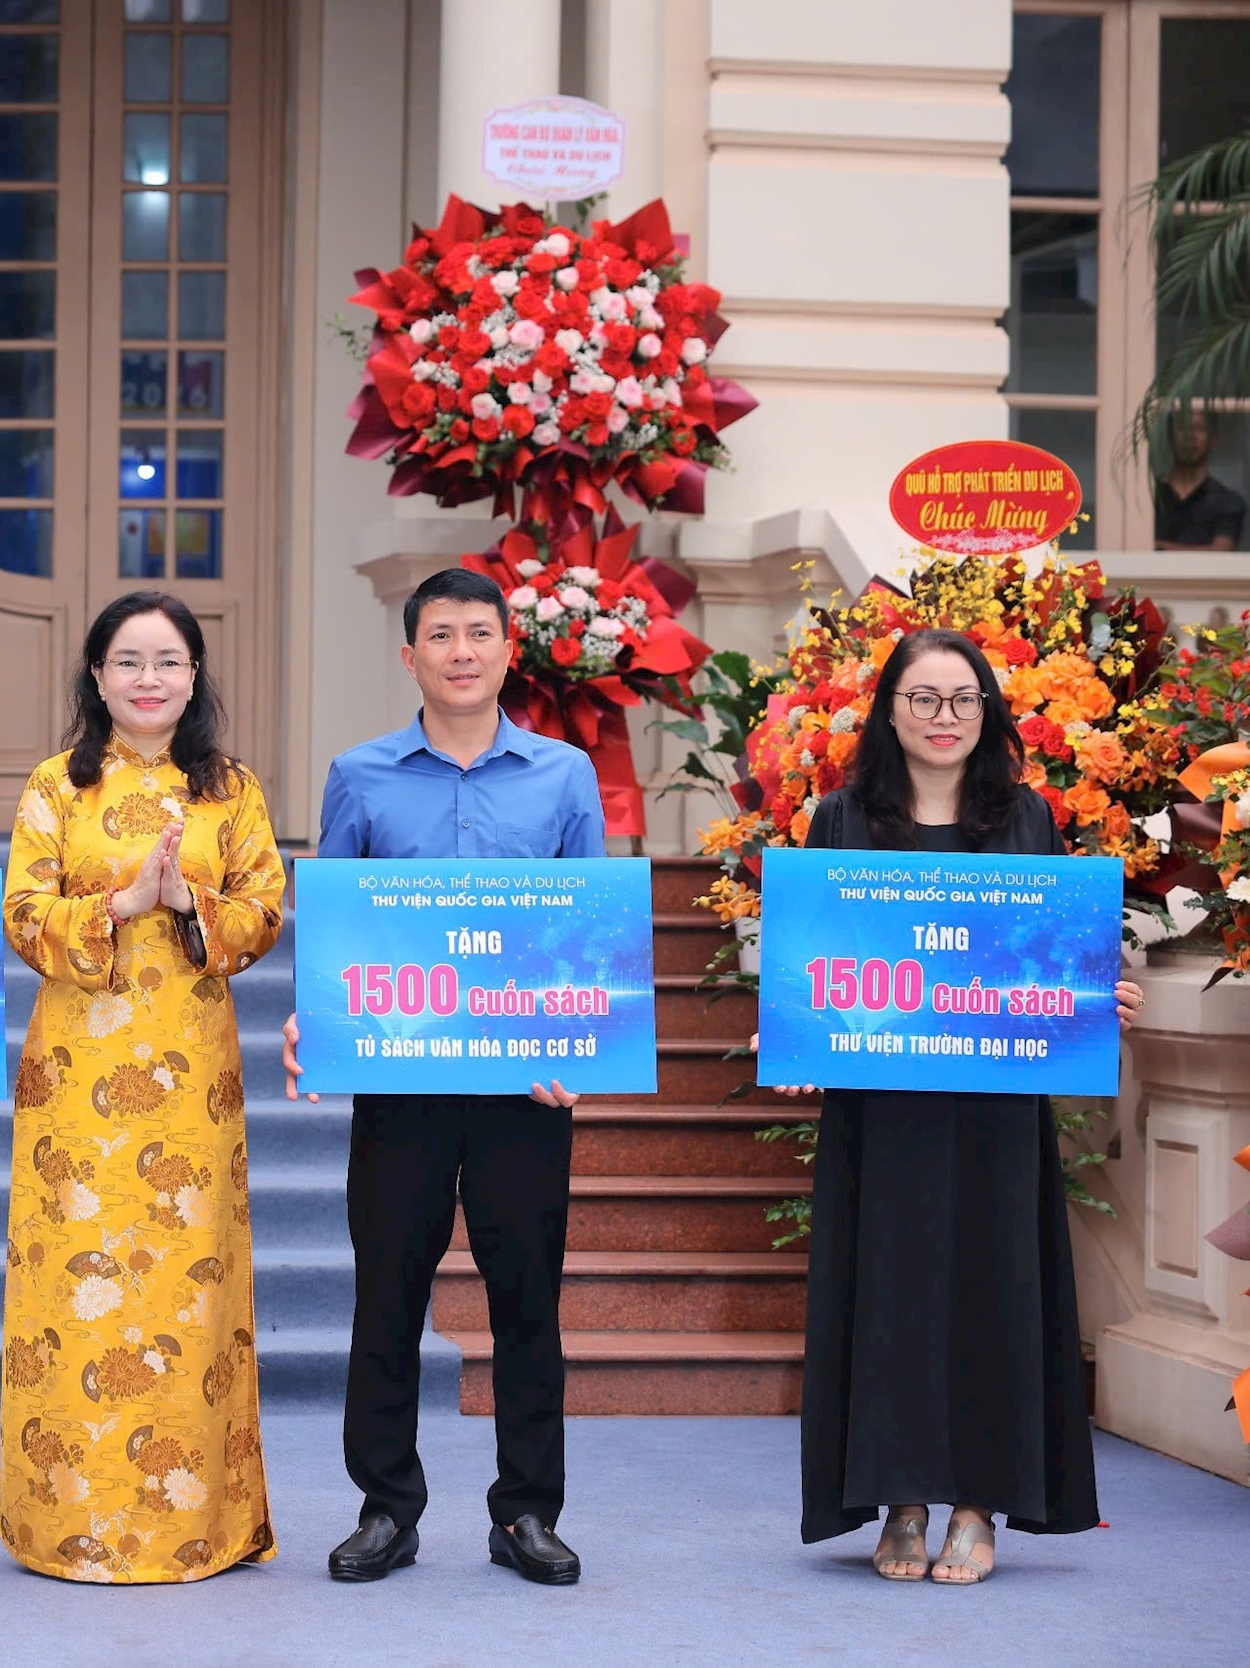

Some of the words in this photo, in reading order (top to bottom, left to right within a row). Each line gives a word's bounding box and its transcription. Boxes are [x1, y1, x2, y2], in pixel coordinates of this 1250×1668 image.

[928, 465, 941, 493] HỖ
[943, 471, 962, 498] TRỢ
[964, 467, 989, 493] PHÁT
[992, 462, 1021, 492] TRIỂN
[1024, 470, 1038, 492] DU
[1040, 469, 1064, 496] LỊCH
[920, 500, 976, 531] Chúc
[980, 500, 1049, 535] Mừng
[359, 875, 378, 890] BỘ
[381, 876, 409, 888] VĂN
[413, 875, 445, 889] HÓA,
[450, 873, 471, 888] THỂ
[475, 878, 510, 888] THAO
[513, 875, 532, 888] VÀ
[536, 877, 553, 888] DU
[557, 877, 585, 890] LỊCH
[828, 867, 846, 882] BỘ
[850, 868, 878, 881] VĂN
[882, 869, 914, 882] HÓA,
[919, 867, 940, 882] THỂ
[944, 872, 980, 884] THAO
[983, 871, 1002, 884] VÀ
[1006, 874, 1024, 885] DU
[1028, 875, 1056, 887] LỊCH
[372, 895, 398, 906] THƯ
[402, 893, 431, 909] VIỆN
[436, 892, 477, 906] QUỐC
[482, 896, 506, 906] GIA
[510, 893, 537, 908] VIỆT
[542, 896, 572, 906] NAM
[840, 888, 866, 899] THƯ
[870, 886, 900, 902] VIỆN
[904, 886, 946, 901] QUỐC
[950, 891, 976, 902] GIA
[980, 890, 1007, 905] VIỆT
[1011, 893, 1042, 904] NAM
[446, 927, 501, 959] TẶNG
[913, 922, 969, 954] TẶNG
[341, 964, 459, 1017] 1500
[544, 984, 609, 1016] sách
[806, 957, 923, 1012] 1500
[1006, 983, 1076, 1016] sách
[356, 1034, 375, 1057] TỦ
[382, 1036, 424, 1057] SÁCH
[430, 1037, 462, 1057] VĂN
[469, 1036, 501, 1057] HÓA
[507, 1039, 540, 1060] ĐỌC
[547, 1038, 568, 1056] CƠ
[574, 1034, 596, 1056] SỞ
[830, 1032, 862, 1052] THƯ
[866, 1032, 903, 1056] VIỆN
[909, 1033, 974, 1055] TRƯỜNG
[980, 1038, 1008, 1059] ĐẠI
[1014, 1039, 1047, 1060] HỌC
